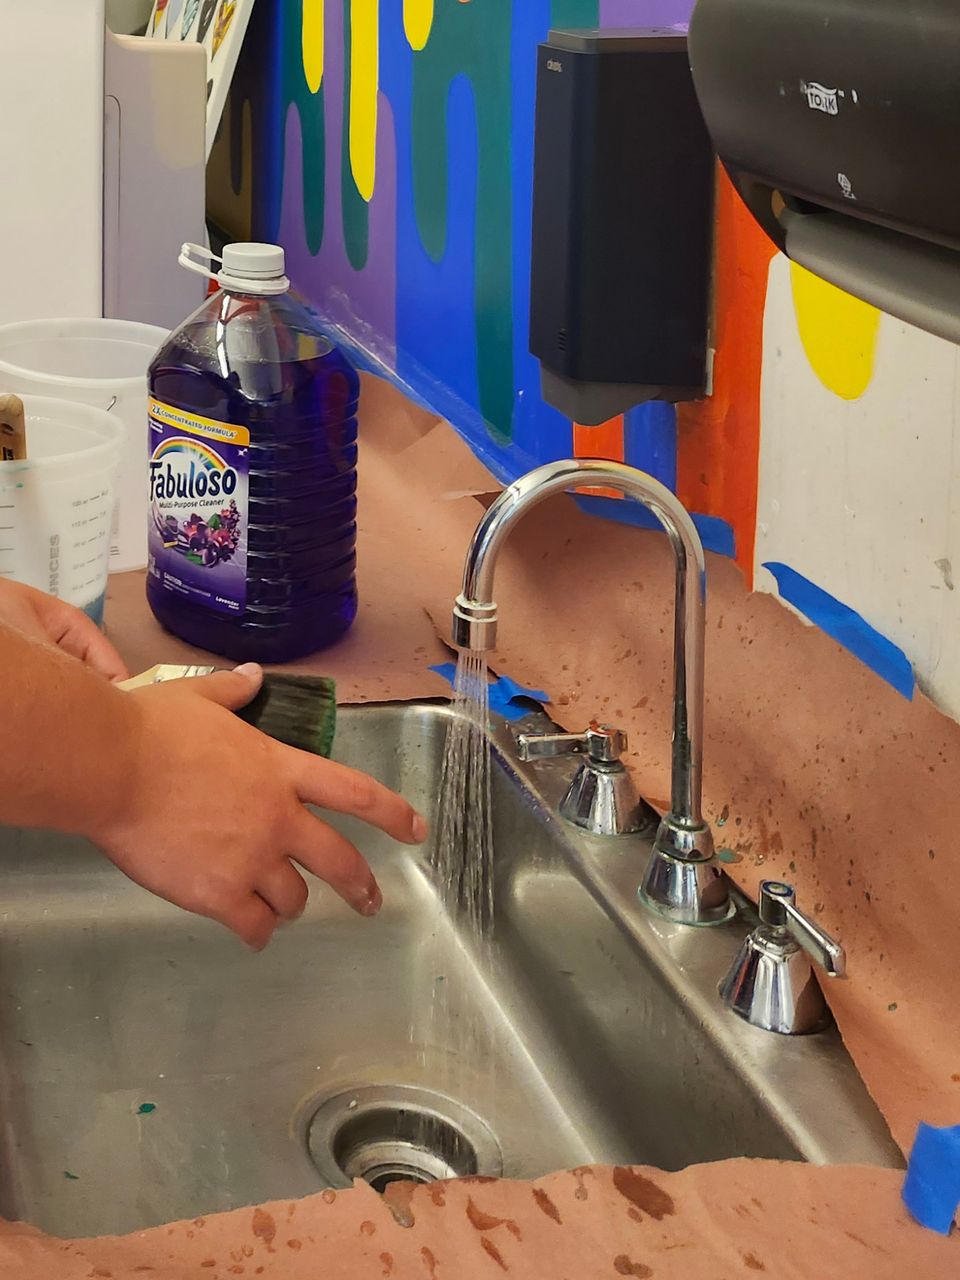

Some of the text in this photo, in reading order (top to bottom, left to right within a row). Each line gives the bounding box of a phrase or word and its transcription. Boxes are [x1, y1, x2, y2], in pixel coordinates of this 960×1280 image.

[161, 409, 203, 430] CONCENTRATED
[203, 424, 235, 438] FORMULA
[149, 460, 237, 502] Fabuloso
[159, 498, 224, 509] Multi-Purpose Cleaner
